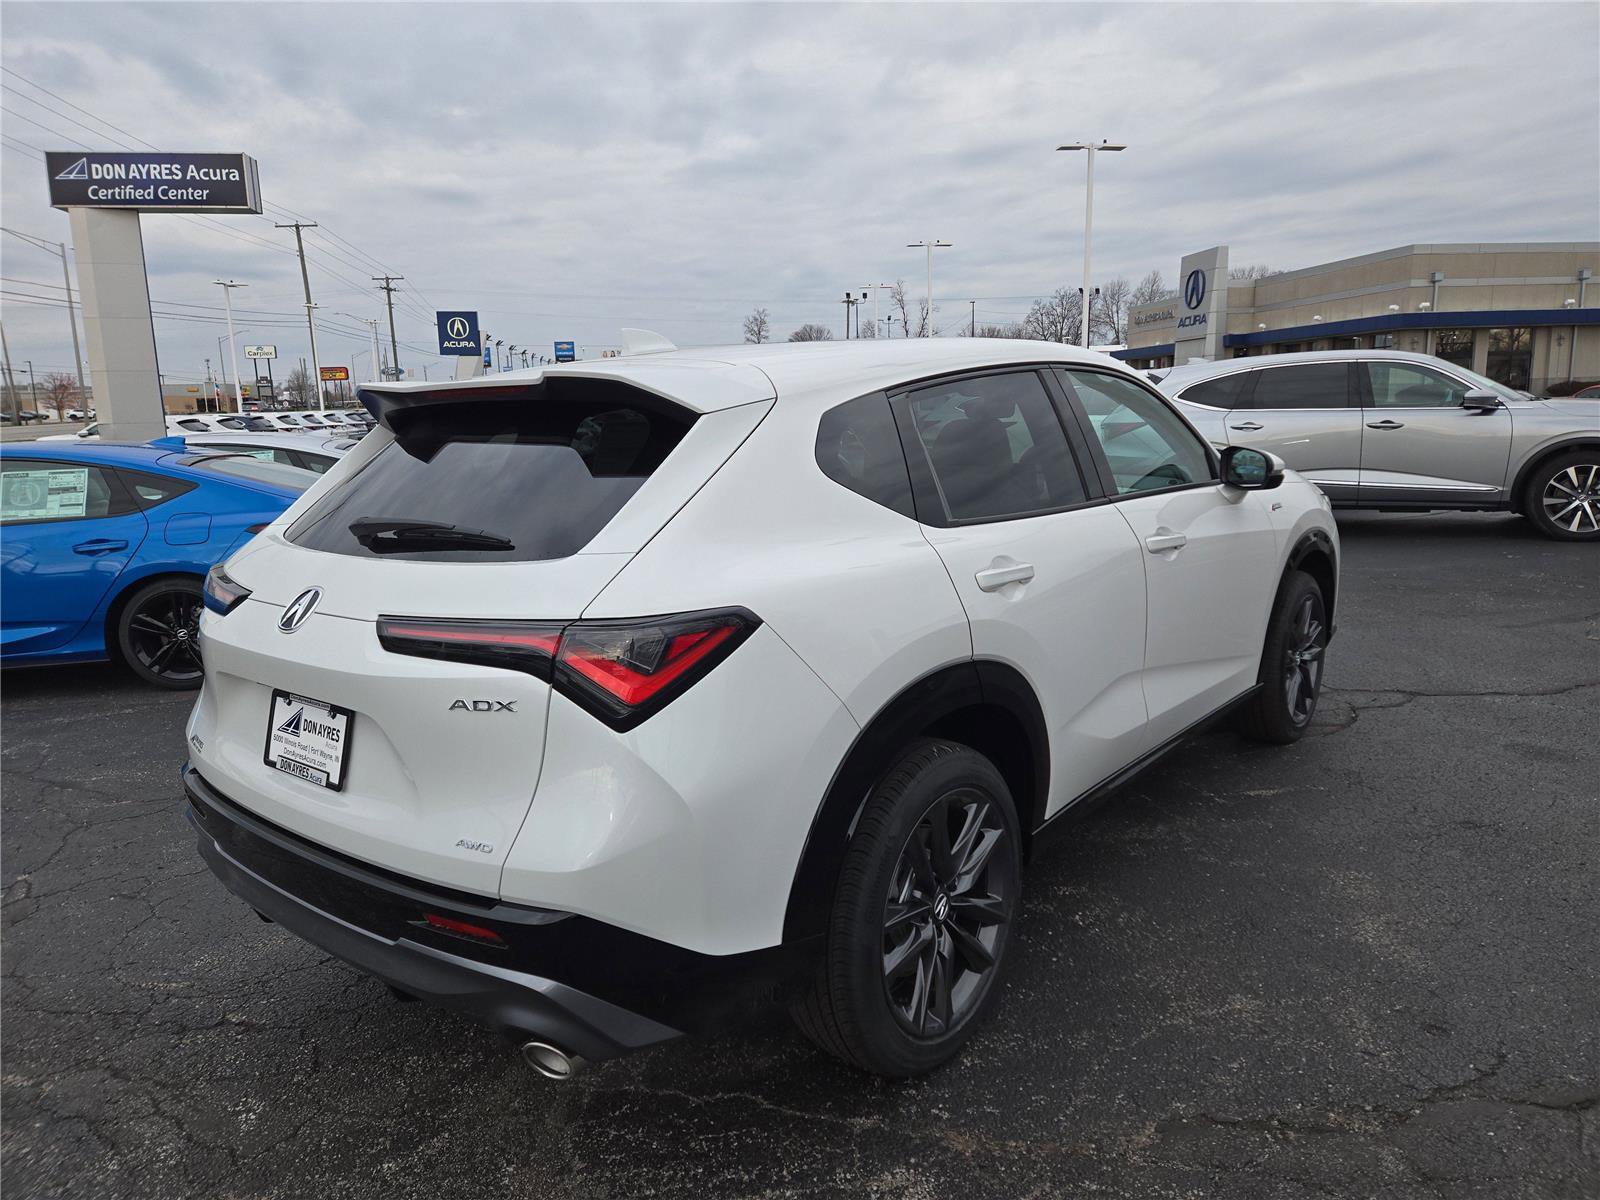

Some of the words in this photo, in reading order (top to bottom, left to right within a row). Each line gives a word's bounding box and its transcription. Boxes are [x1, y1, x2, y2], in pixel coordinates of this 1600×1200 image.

[91, 163, 126, 180] DON
[128, 164, 182, 180] AYRES
[186, 164, 240, 181] Acura
[87, 185, 154, 200] Certified
[157, 185, 209, 200] Center
[1177, 313, 1208, 328] ACURA
[442, 340, 476, 348] ACURA
[448, 699, 518, 713] ADX
[303, 719, 317, 735] DON
[317, 724, 340, 742] AYRES
[280, 759, 292, 770] DON
[292, 762, 310, 778] AYRES
[455, 839, 493, 854] AWD
